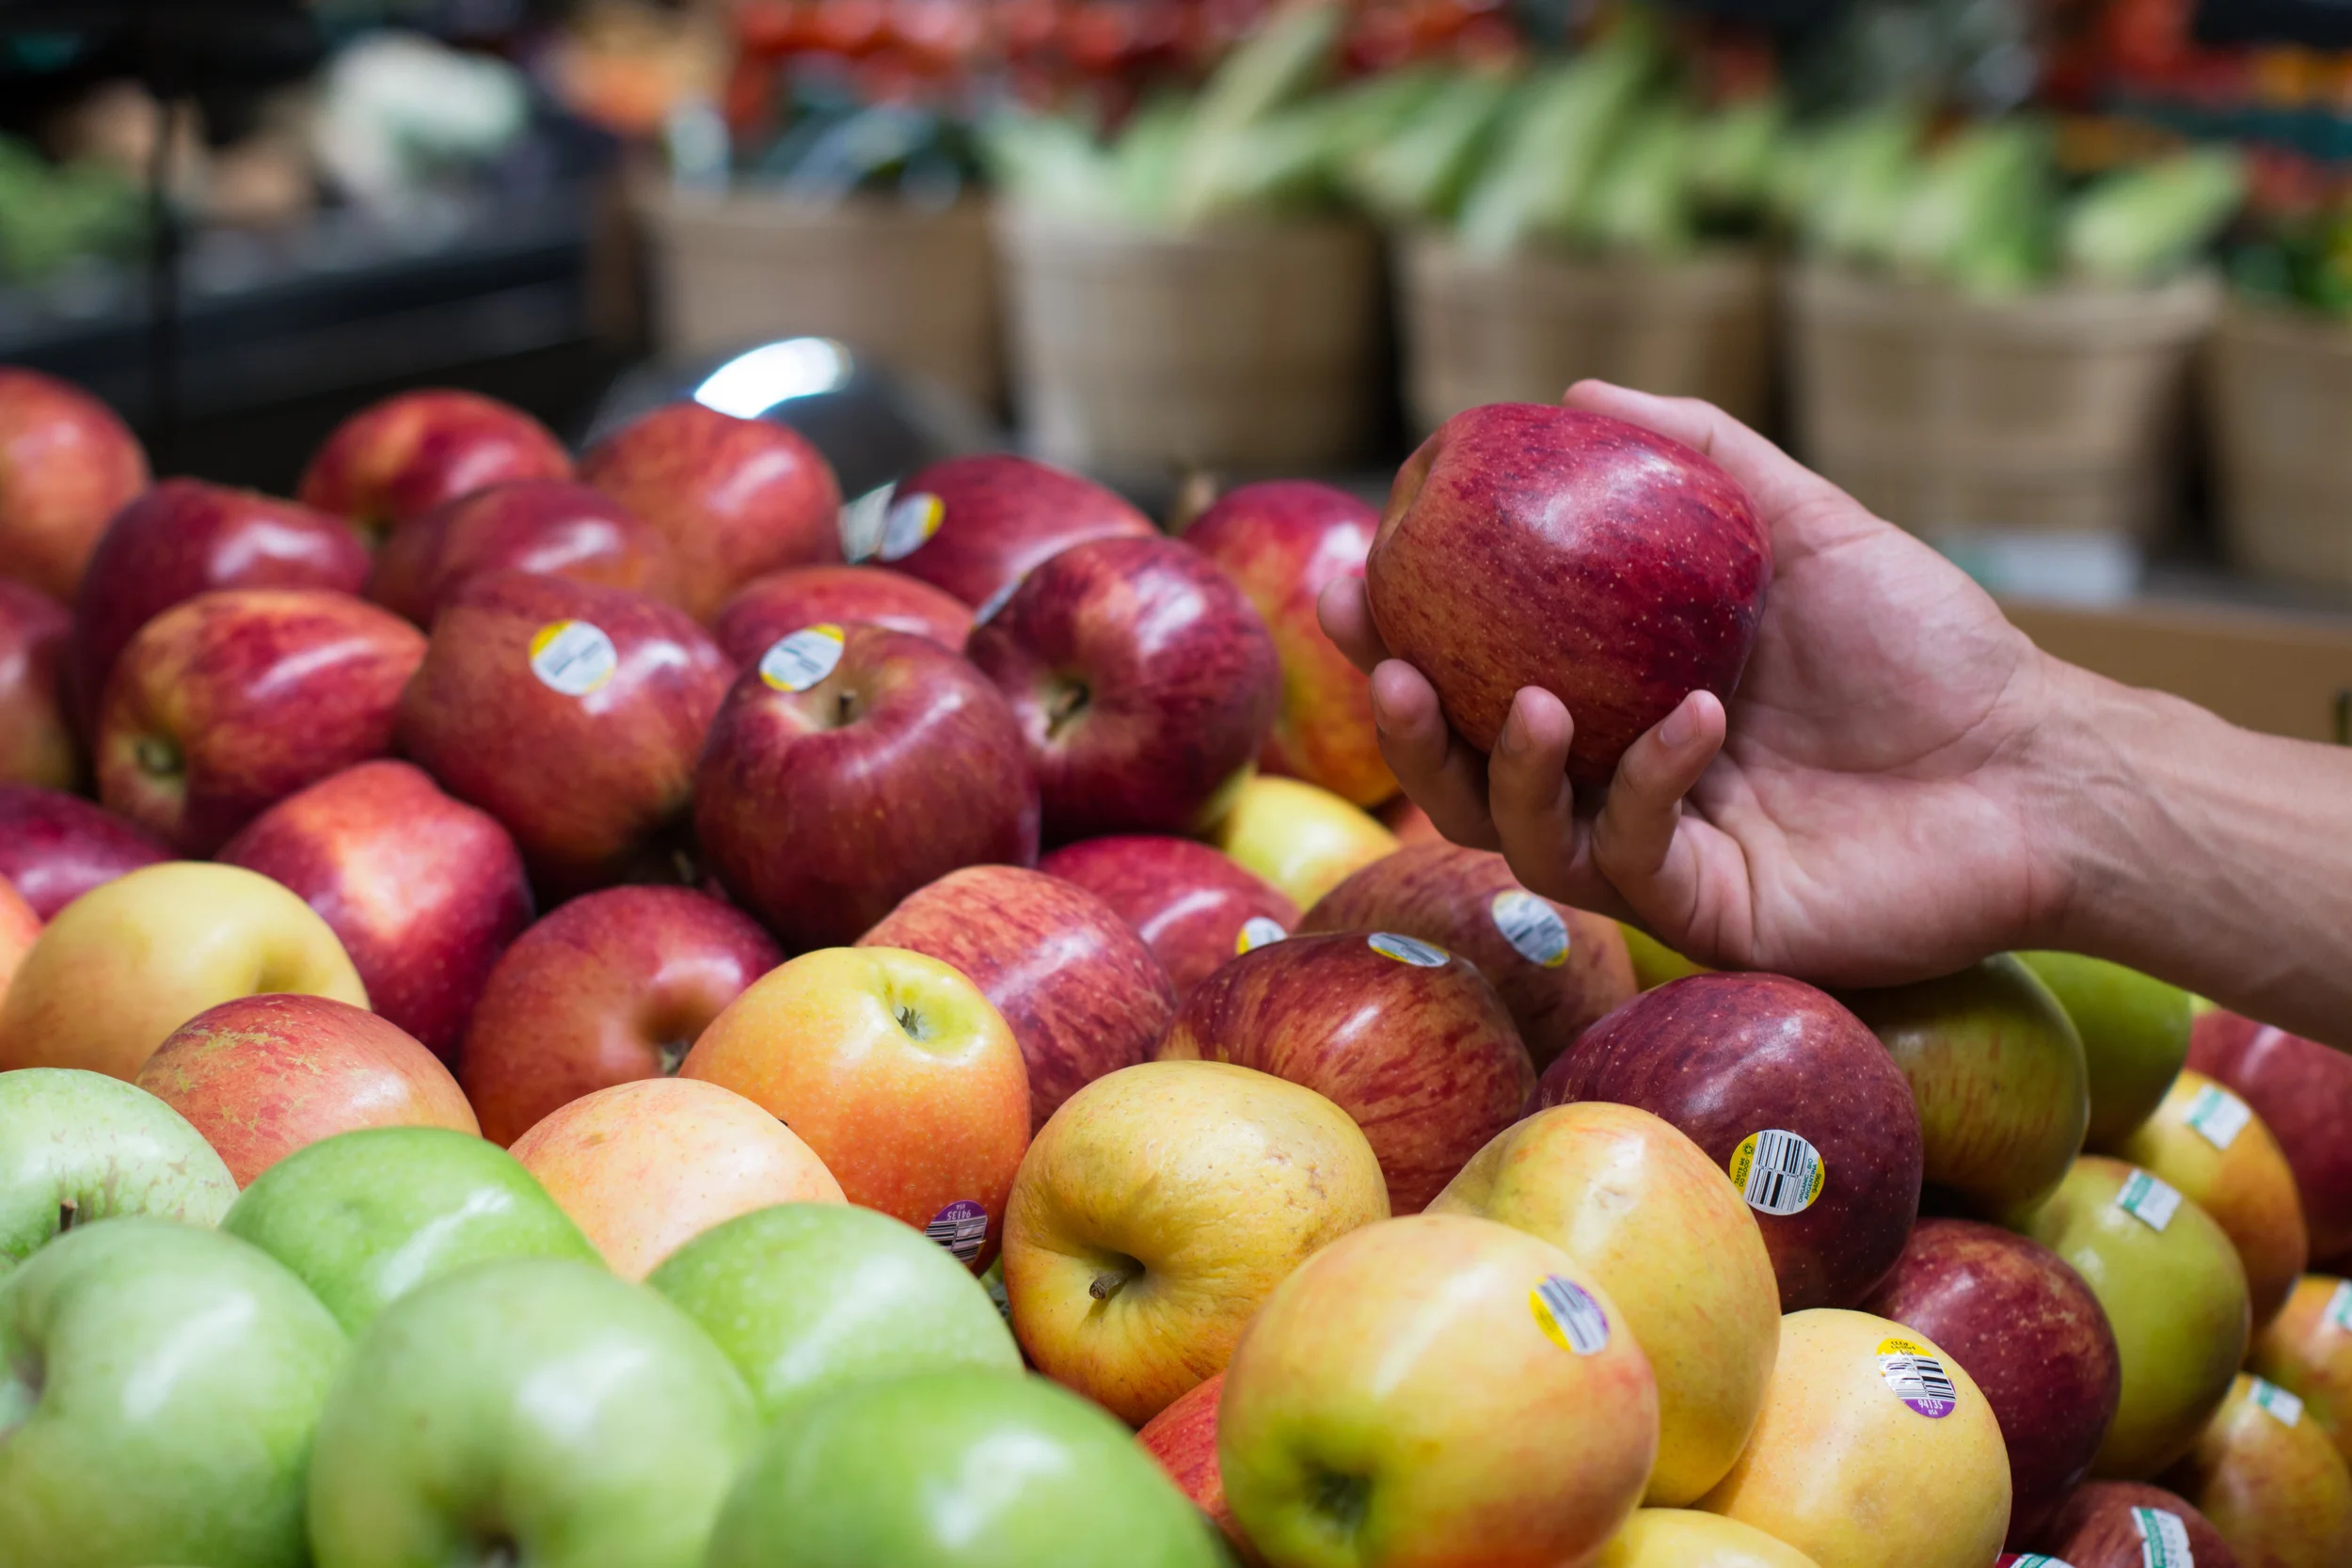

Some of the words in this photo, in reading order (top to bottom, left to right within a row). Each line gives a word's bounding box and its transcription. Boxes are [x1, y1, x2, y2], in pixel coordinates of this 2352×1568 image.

[1740, 1157, 1745, 1165] ME
[1741, 1159, 1750, 1177] GOOD
[1740, 1178, 1745, 1187] DO
[1798, 1174, 1809, 1203] ORGANIC
[1804, 1164, 1817, 1200] ARGENTINA
[1812, 1173, 1821, 1194] 94016
[947, 1210, 971, 1220] 94135
[1918, 1400, 1943, 1409] 94135
